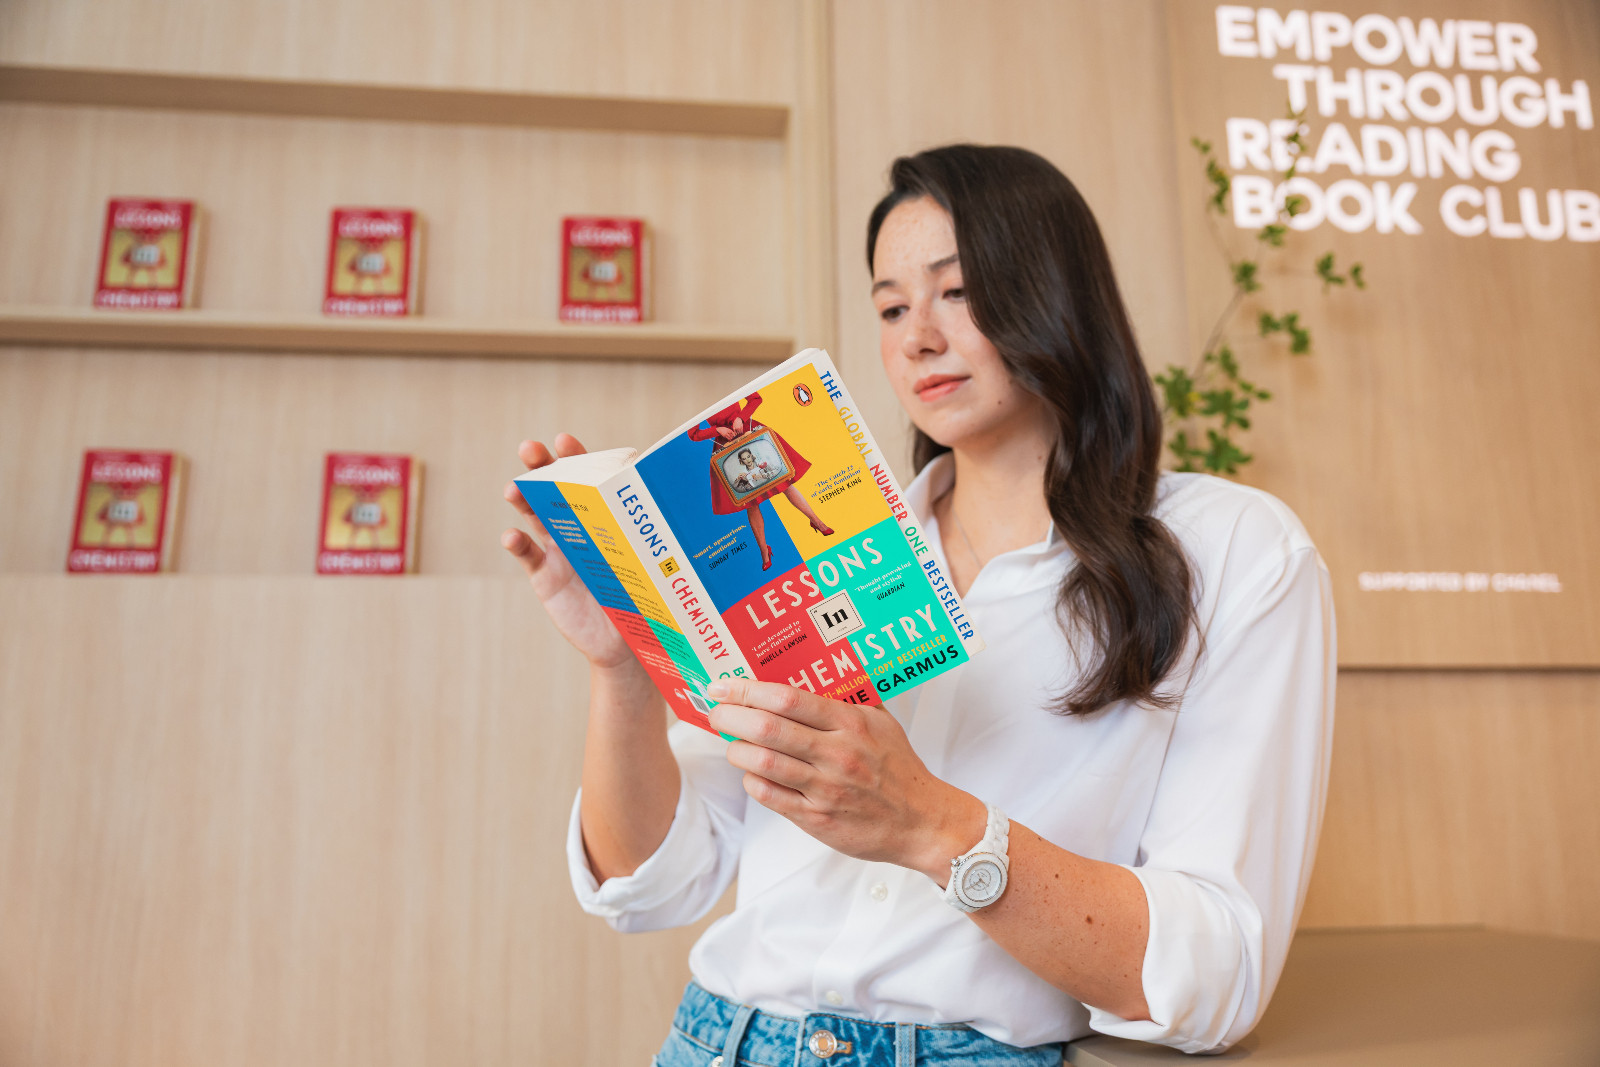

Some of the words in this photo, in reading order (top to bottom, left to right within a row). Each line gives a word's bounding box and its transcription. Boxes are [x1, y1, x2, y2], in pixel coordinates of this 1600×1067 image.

[1215, 5, 1541, 73] EMPOWER
[1272, 64, 1594, 130] THROUGH
[1226, 117, 1521, 182] READING
[1232, 175, 1424, 234] BOOK
[1439, 184, 1600, 242] CLUB
[616, 484, 668, 558] LESSONS
[818, 485, 846, 504] STEPHEN
[846, 476, 862, 490] KING
[820, 370, 842, 402] THE
[839, 406, 873, 460] GLOBAL
[869, 463, 908, 522] NUMBER
[904, 526, 929, 557] ONE
[922, 559, 974, 641] BESTSELLER
[708, 552, 730, 571] SUNDAY
[730, 541, 748, 556] TIMES
[745, 537, 883, 630] LESSONS
[671, 577, 730, 661] CHEMISTRY
[820, 608, 849, 630] In
[876, 581, 906, 601] GUARDIAN
[759, 649, 784, 667] NIGELLA
[783, 633, 808, 651] LAWSON
[787, 603, 938, 694] HEMISTRY
[876, 644, 959, 693] GARMUS
[896, 634, 948, 665] BESTSELLER
